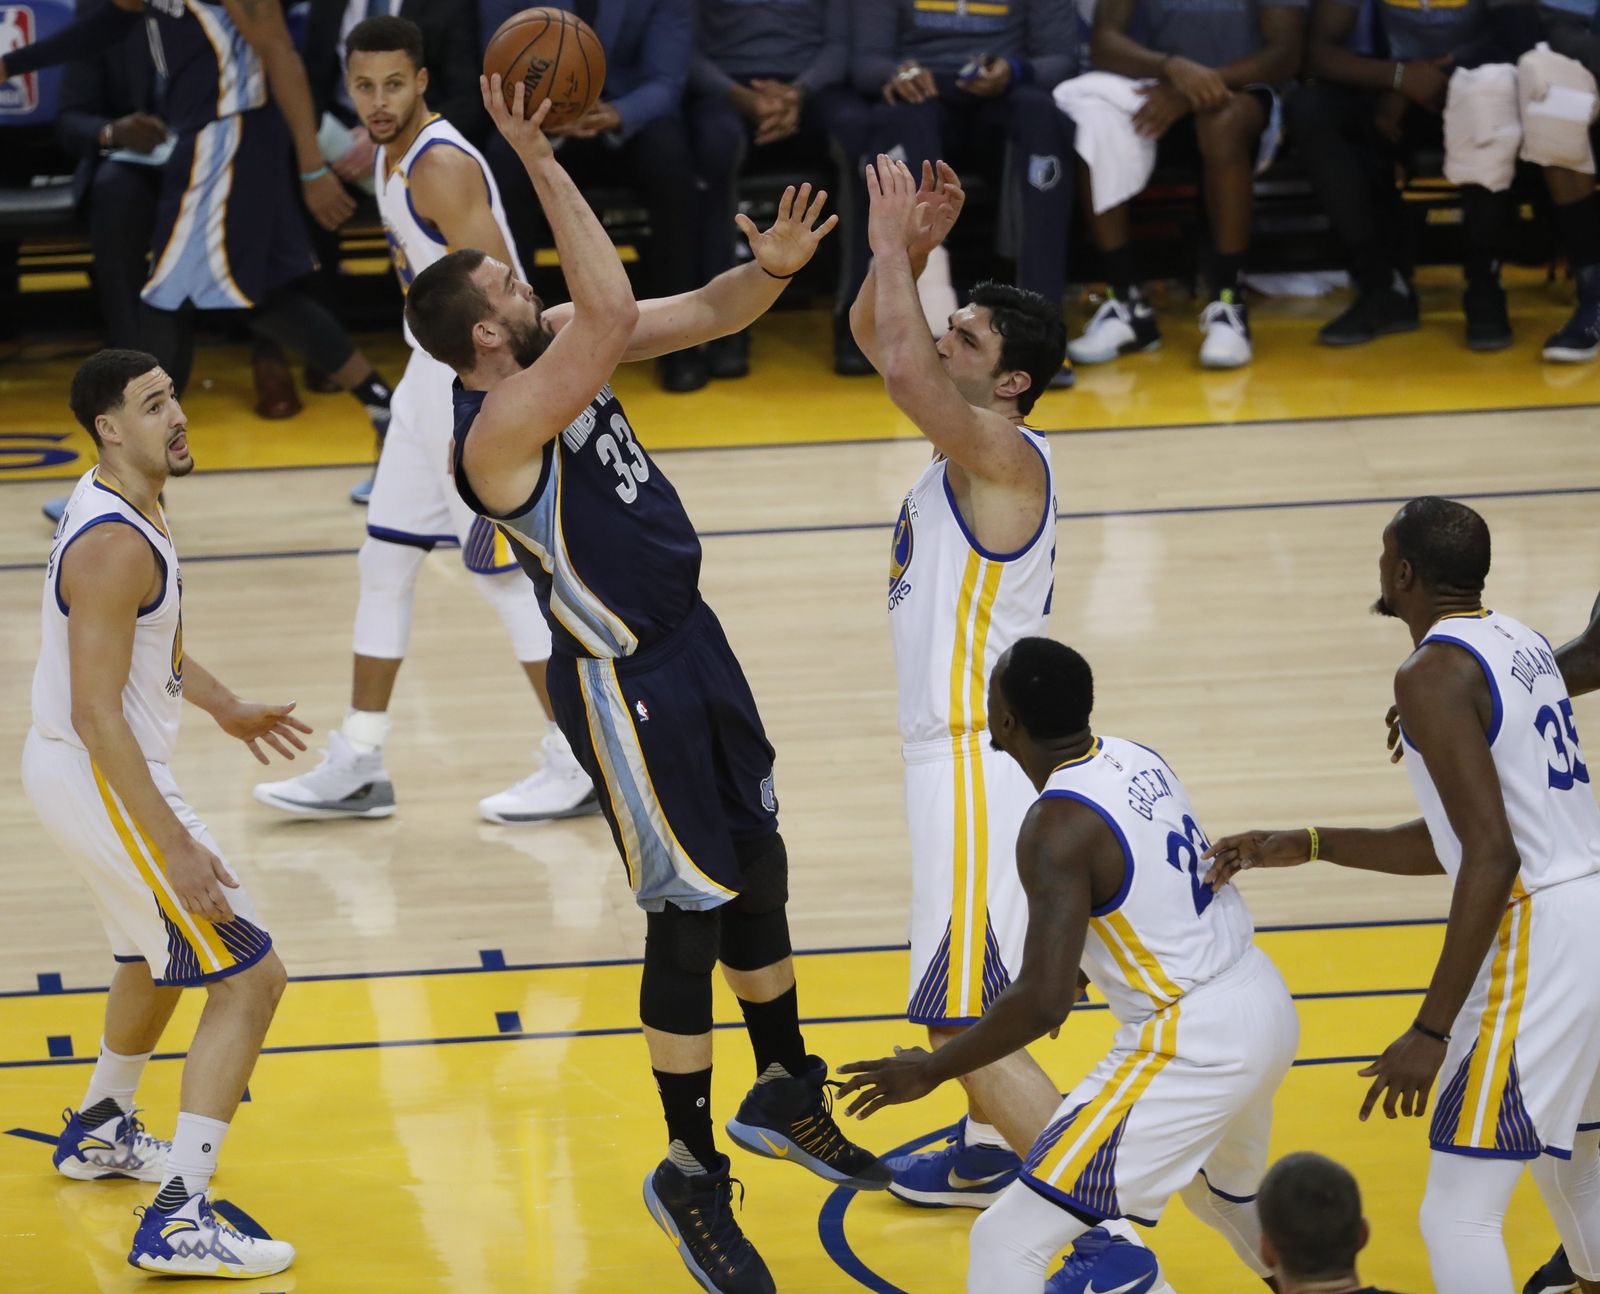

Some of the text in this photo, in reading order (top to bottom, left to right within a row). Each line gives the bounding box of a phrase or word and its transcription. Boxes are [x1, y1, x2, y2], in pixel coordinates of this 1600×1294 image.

[596, 413, 650, 504] 33
[1534, 698, 1590, 790] 35
[1128, 768, 1174, 821] GREEN
